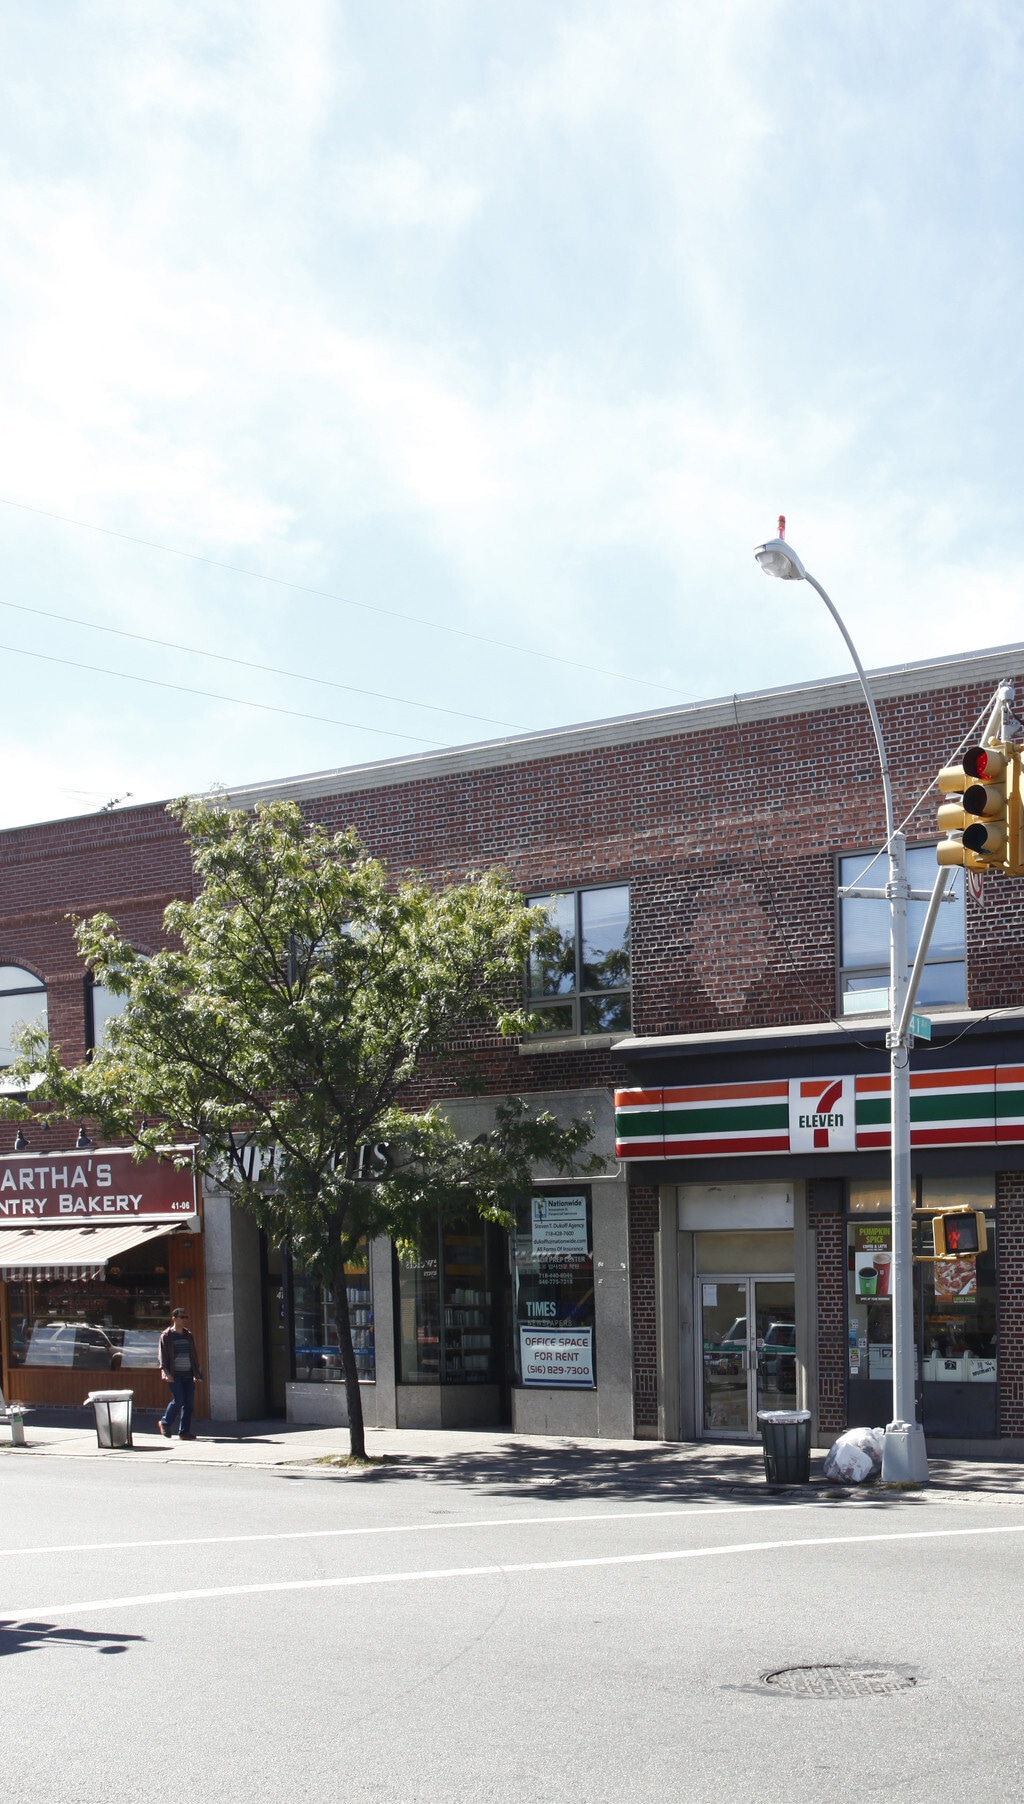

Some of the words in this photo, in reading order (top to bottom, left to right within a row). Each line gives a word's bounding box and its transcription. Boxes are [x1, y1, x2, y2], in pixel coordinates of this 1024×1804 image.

[171, 1201, 190, 1210] 41-06
[859, 1228, 890, 1236] PUMPKIN
[526, 1301, 556, 1317] TIMES
[525, 1337, 556, 1347] OFFICE
[559, 1338, 588, 1347] SPACE
[534, 1352, 552, 1360] FOR
[555, 1352, 579, 1361] RENT
[527, 1364, 546, 1374] (516)
[547, 1366, 589, 1375] 829-7300
